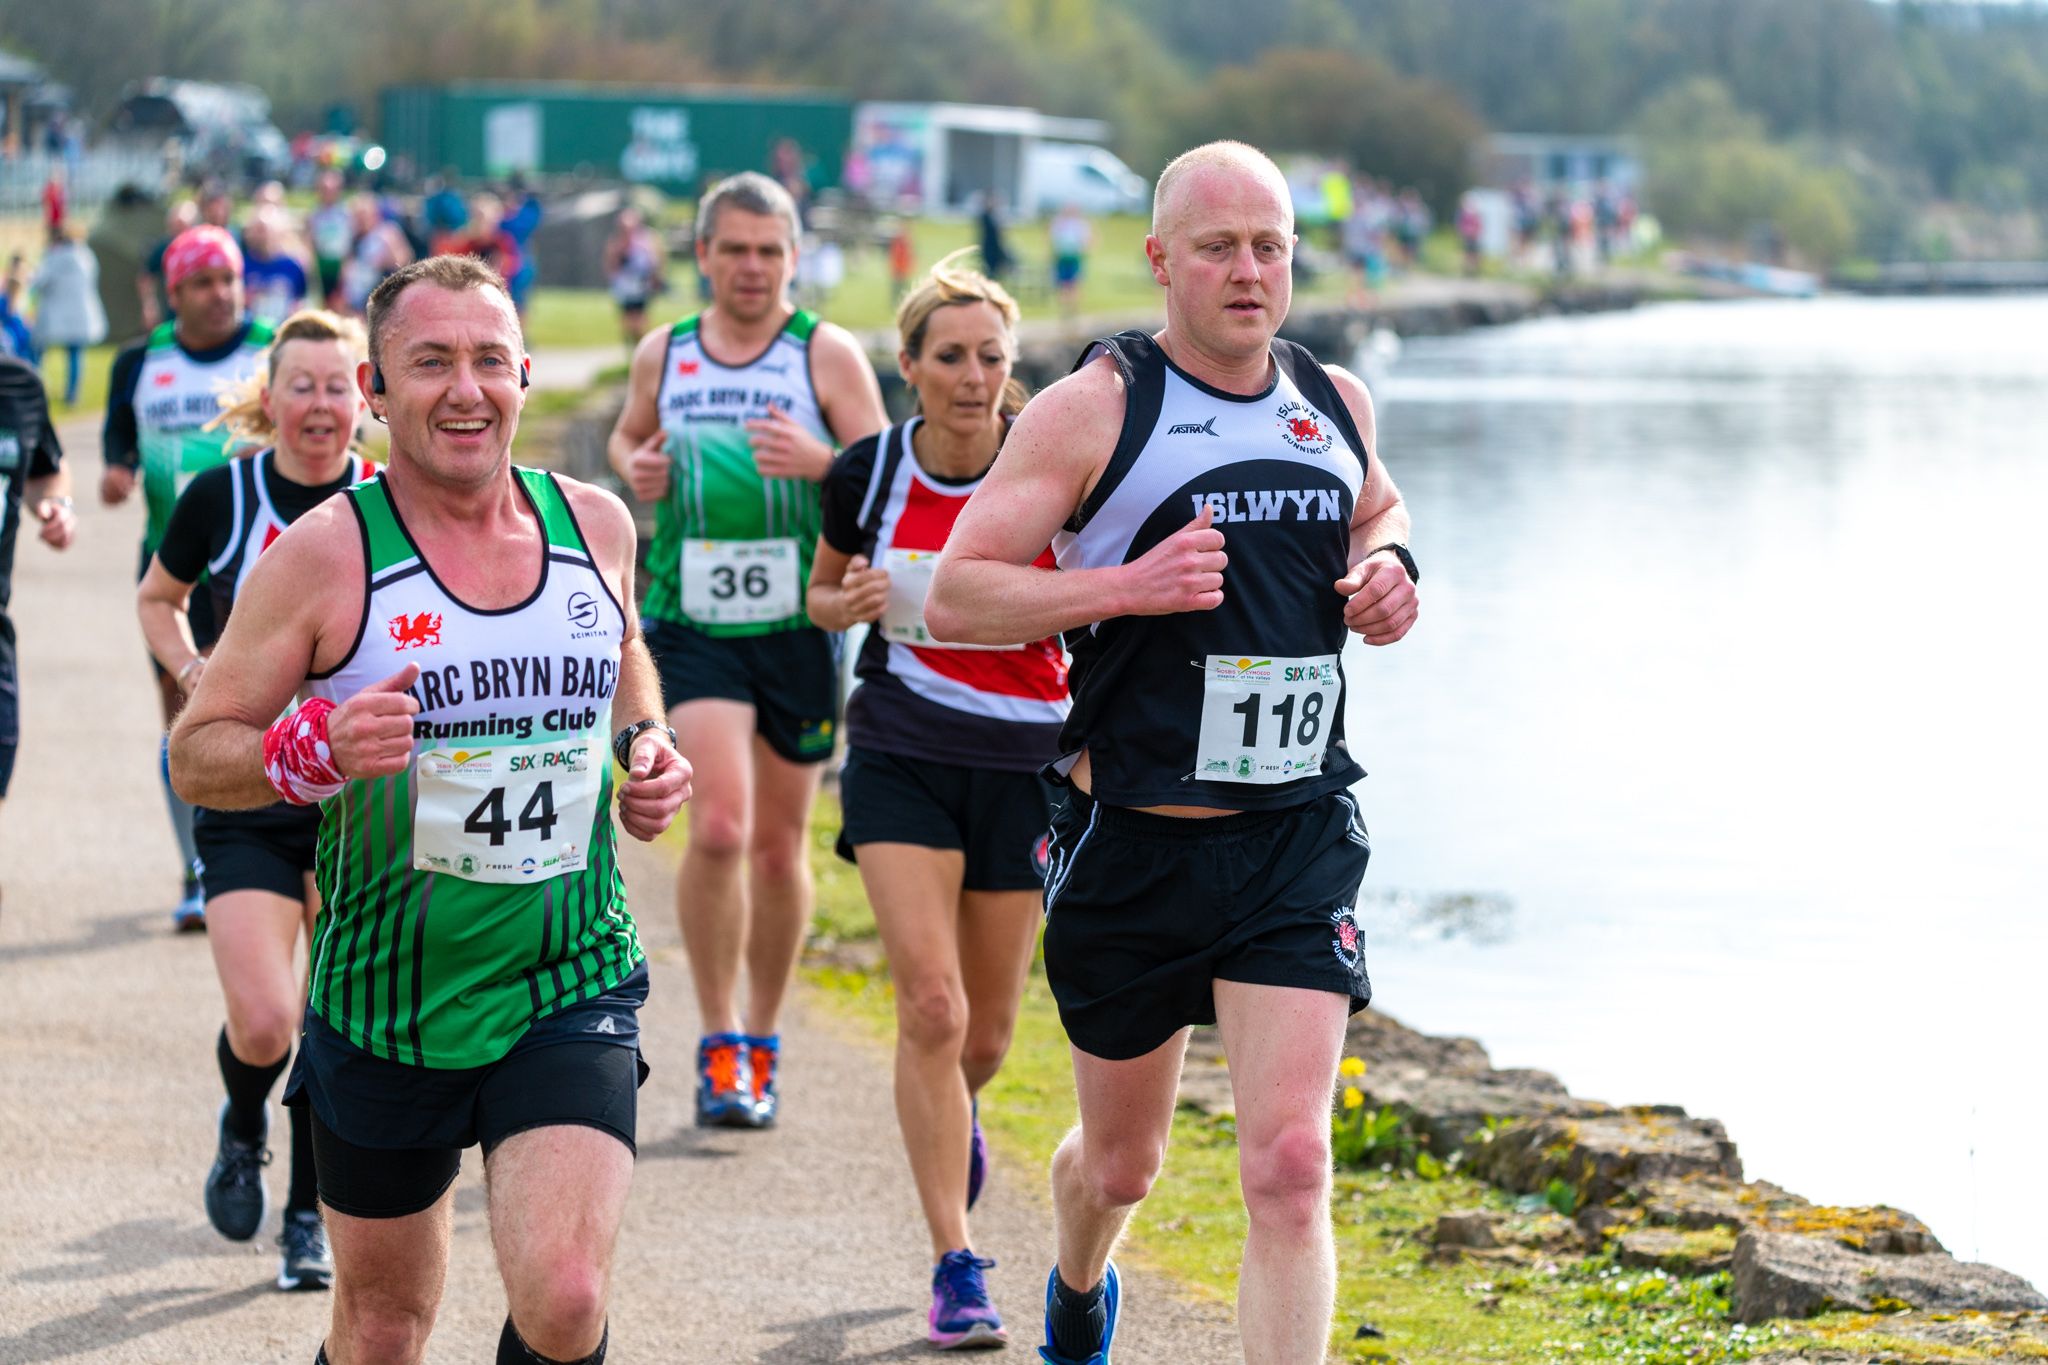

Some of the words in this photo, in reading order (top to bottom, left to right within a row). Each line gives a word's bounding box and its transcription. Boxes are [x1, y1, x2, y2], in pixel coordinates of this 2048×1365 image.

[1276, 401, 1319, 421] ISLWYN
[1167, 416, 1220, 437] FASTRAX
[1281, 433, 1322, 455] RUNNING
[1321, 434, 1333, 453] CLUB
[1192, 489, 1341, 524] ISLWYN
[710, 564, 769, 600] 36
[570, 630, 608, 640] SCIMITAR
[404, 664, 464, 714] ARC
[470, 656, 551, 701] BRYN
[1284, 666, 1305, 682] SIX
[1308, 664, 1331, 681] RACE
[412, 712, 534, 740] Running
[542, 706, 597, 732] Club
[1234, 691, 1324, 748] 118
[510, 754, 537, 772] SIX
[464, 780, 558, 846] 44
